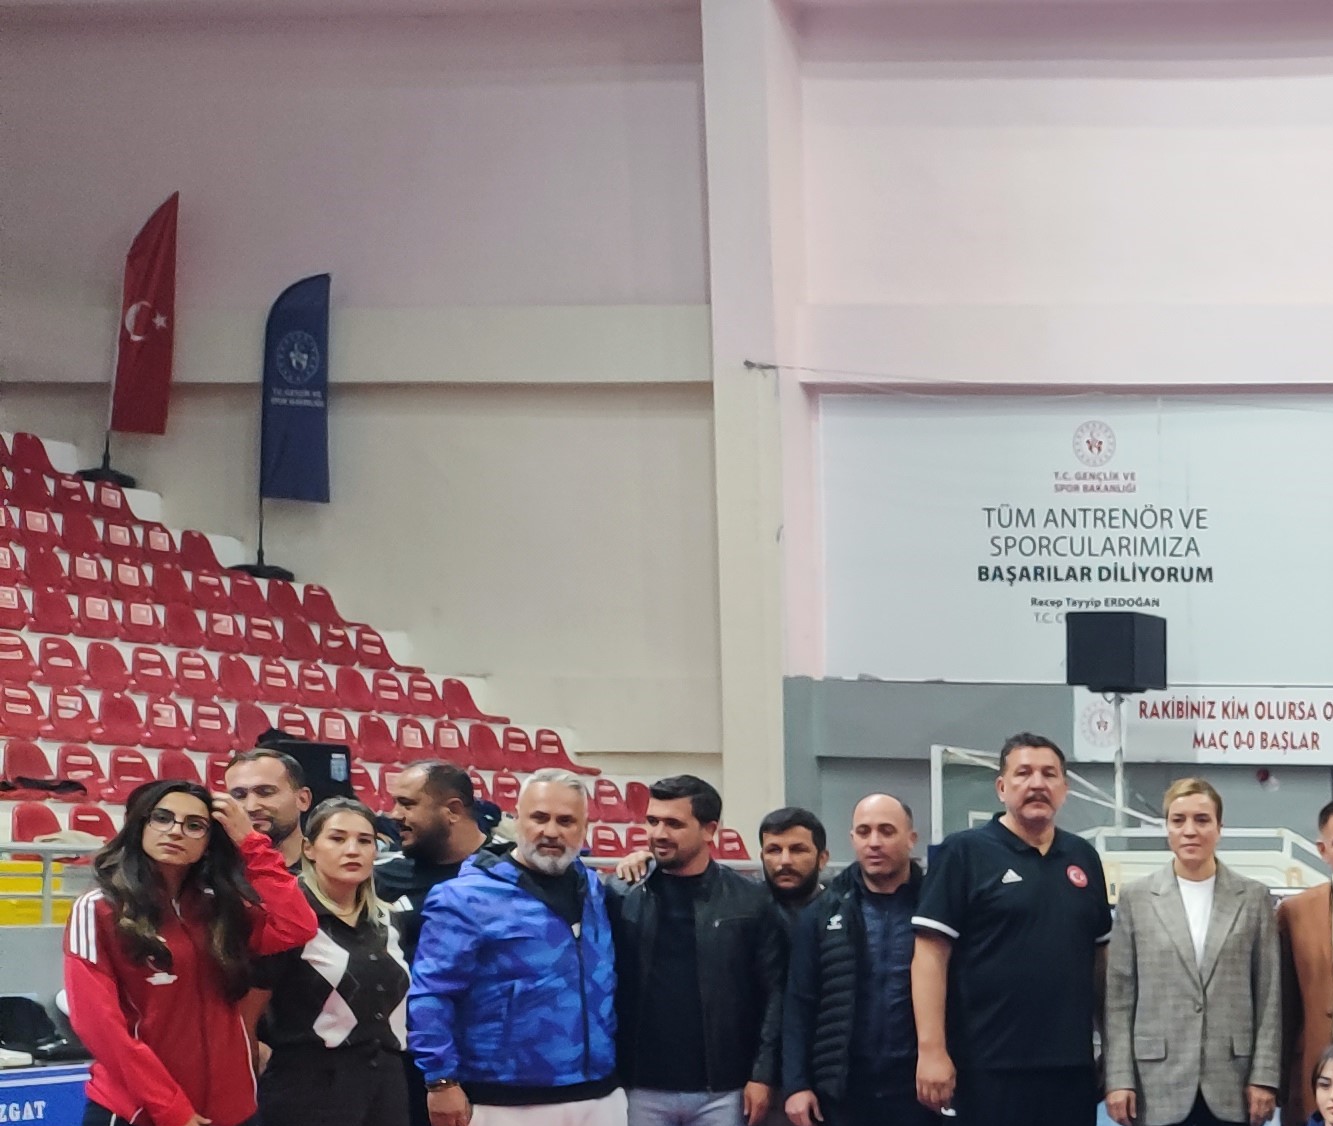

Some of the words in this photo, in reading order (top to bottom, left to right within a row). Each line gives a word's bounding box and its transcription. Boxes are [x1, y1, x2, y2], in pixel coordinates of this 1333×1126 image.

[982, 503, 1036, 529] TÜM
[1043, 503, 1173, 529] ANTRENÖR
[1179, 508, 1208, 529] VE
[990, 535, 1201, 557] SPORCULARIMIZA
[977, 565, 1092, 587] BAŞARILAR
[1098, 562, 1213, 583] DİLİYORUM
[1031, 597, 1063, 609] Recep
[1065, 597, 1101, 609] Tayyip
[1103, 596, 1160, 608] ERDOĞAN
[1139, 695, 1216, 720] RAKİBİNİZ
[1222, 696, 1249, 720] KİM
[1255, 701, 1317, 720] OLURSA
[1193, 730, 1229, 753] MAÇ
[1260, 731, 1320, 754] BAŞLAR
[0, 1101, 46, 1123] ZGAT
